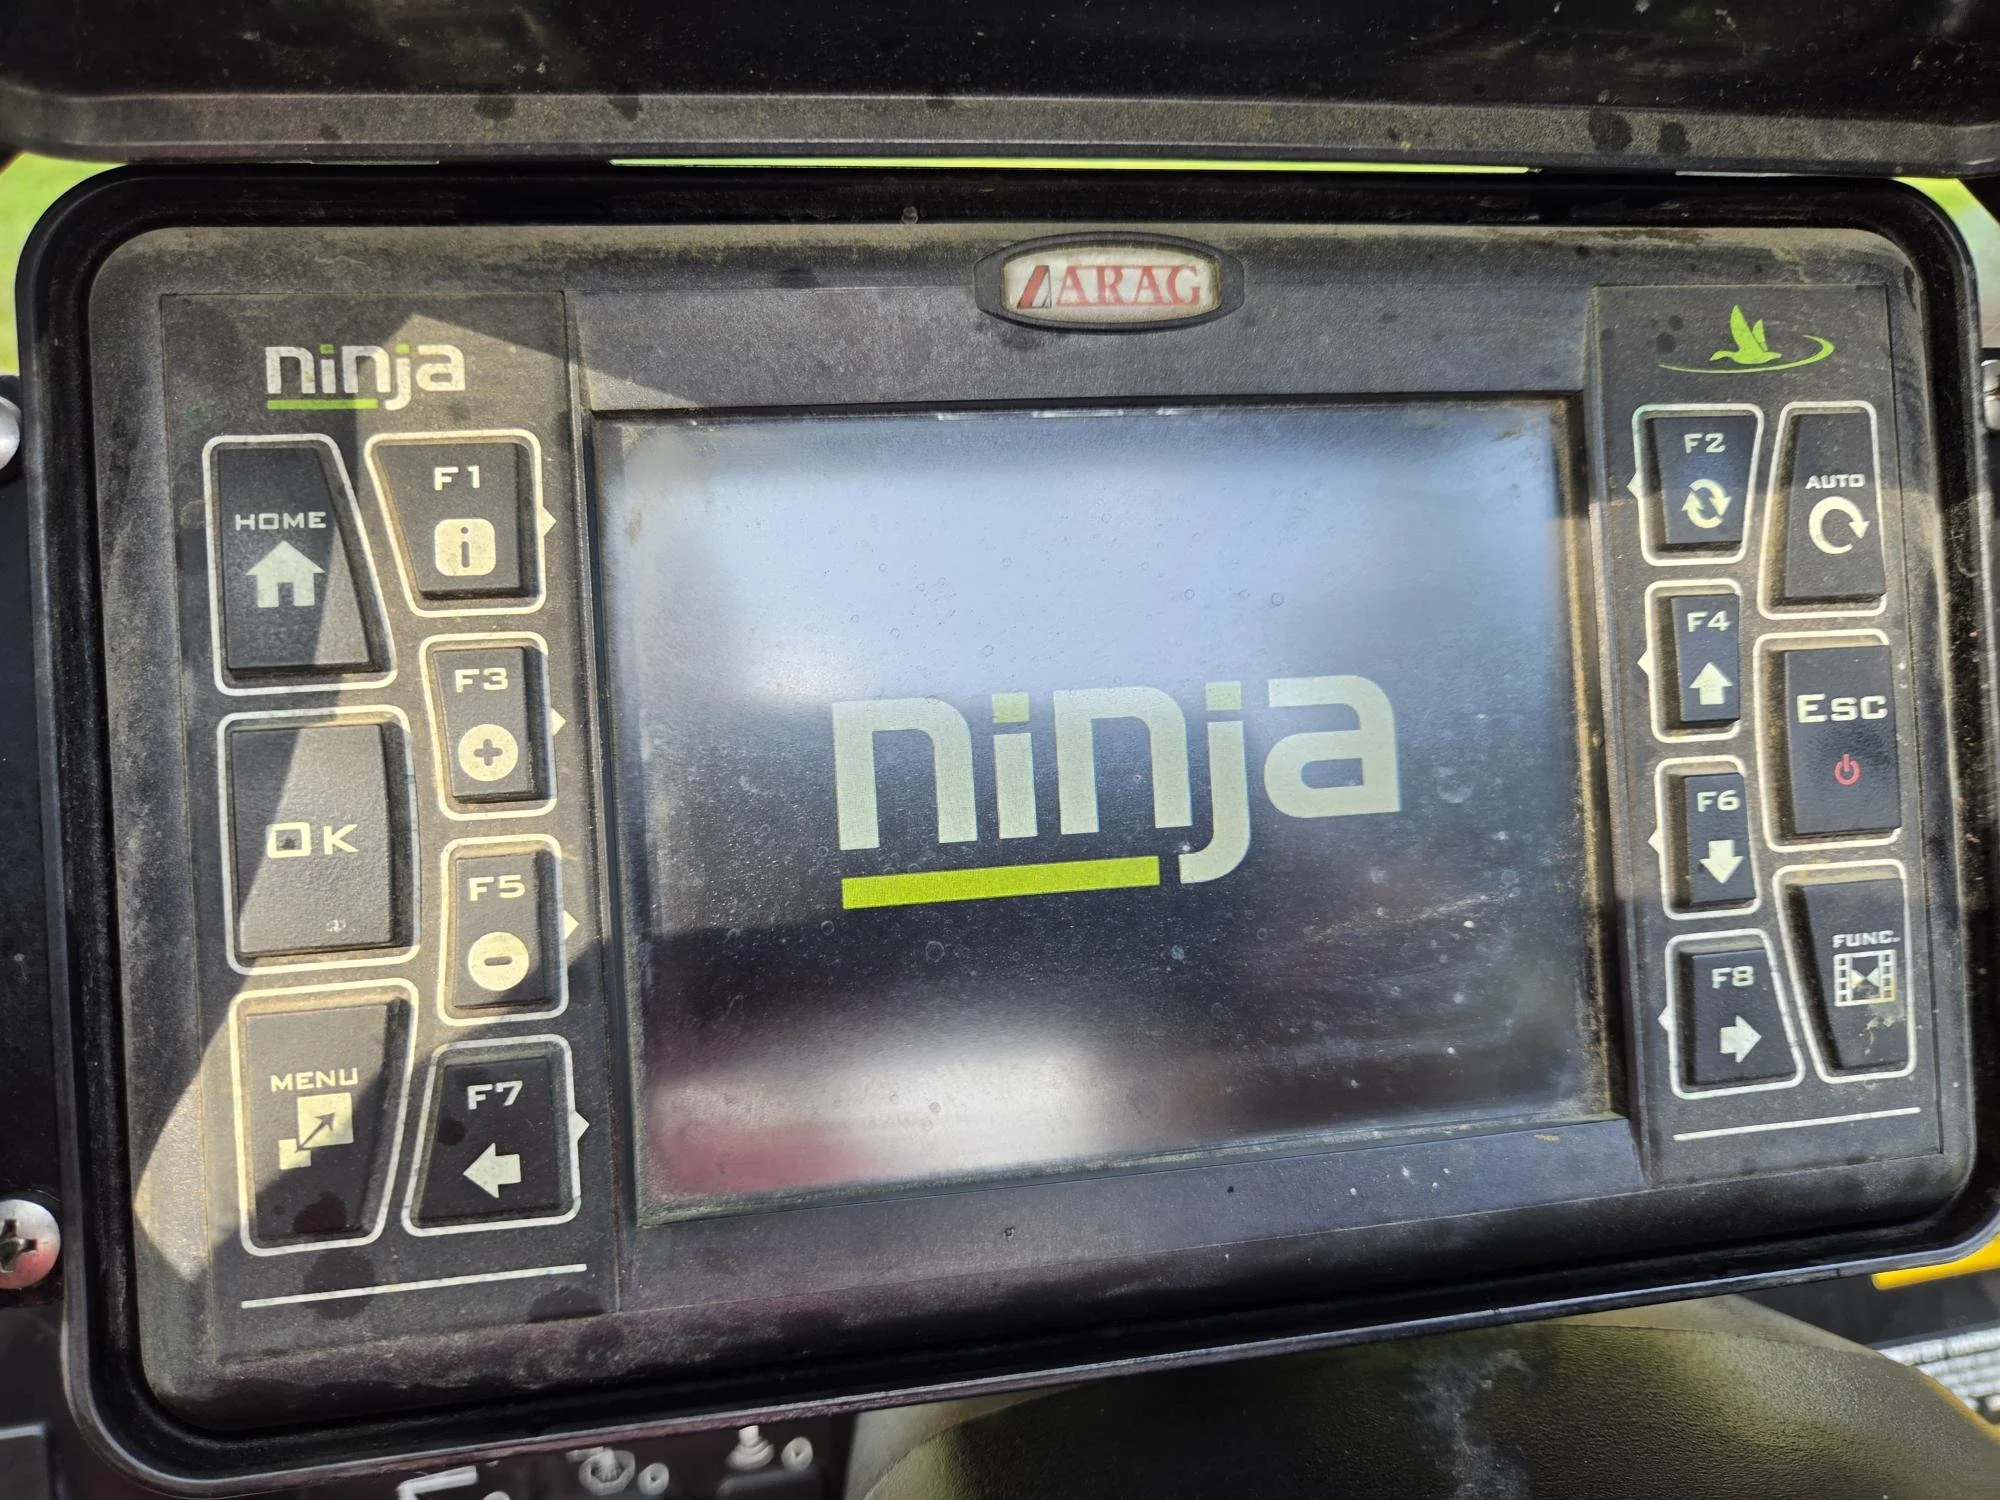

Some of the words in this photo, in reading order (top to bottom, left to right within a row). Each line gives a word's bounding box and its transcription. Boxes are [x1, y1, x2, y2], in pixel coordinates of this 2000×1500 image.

[1056, 264, 1200, 306] ARAG
[265, 344, 466, 411] ninja
[1684, 432, 1726, 454] F2
[433, 465, 481, 491] F1
[1805, 474, 1866, 490] AUTO
[235, 511, 327, 530] HOME
[1687, 611, 1731, 632] F4
[454, 667, 508, 692] F3
[832, 675, 1401, 884] ninja
[1697, 790, 1741, 811] F6
[267, 822, 358, 859] OK
[467, 875, 526, 901] F5
[1711, 966, 1754, 989] F8
[270, 1067, 358, 1092] MENU
[466, 1081, 524, 1110] F7
